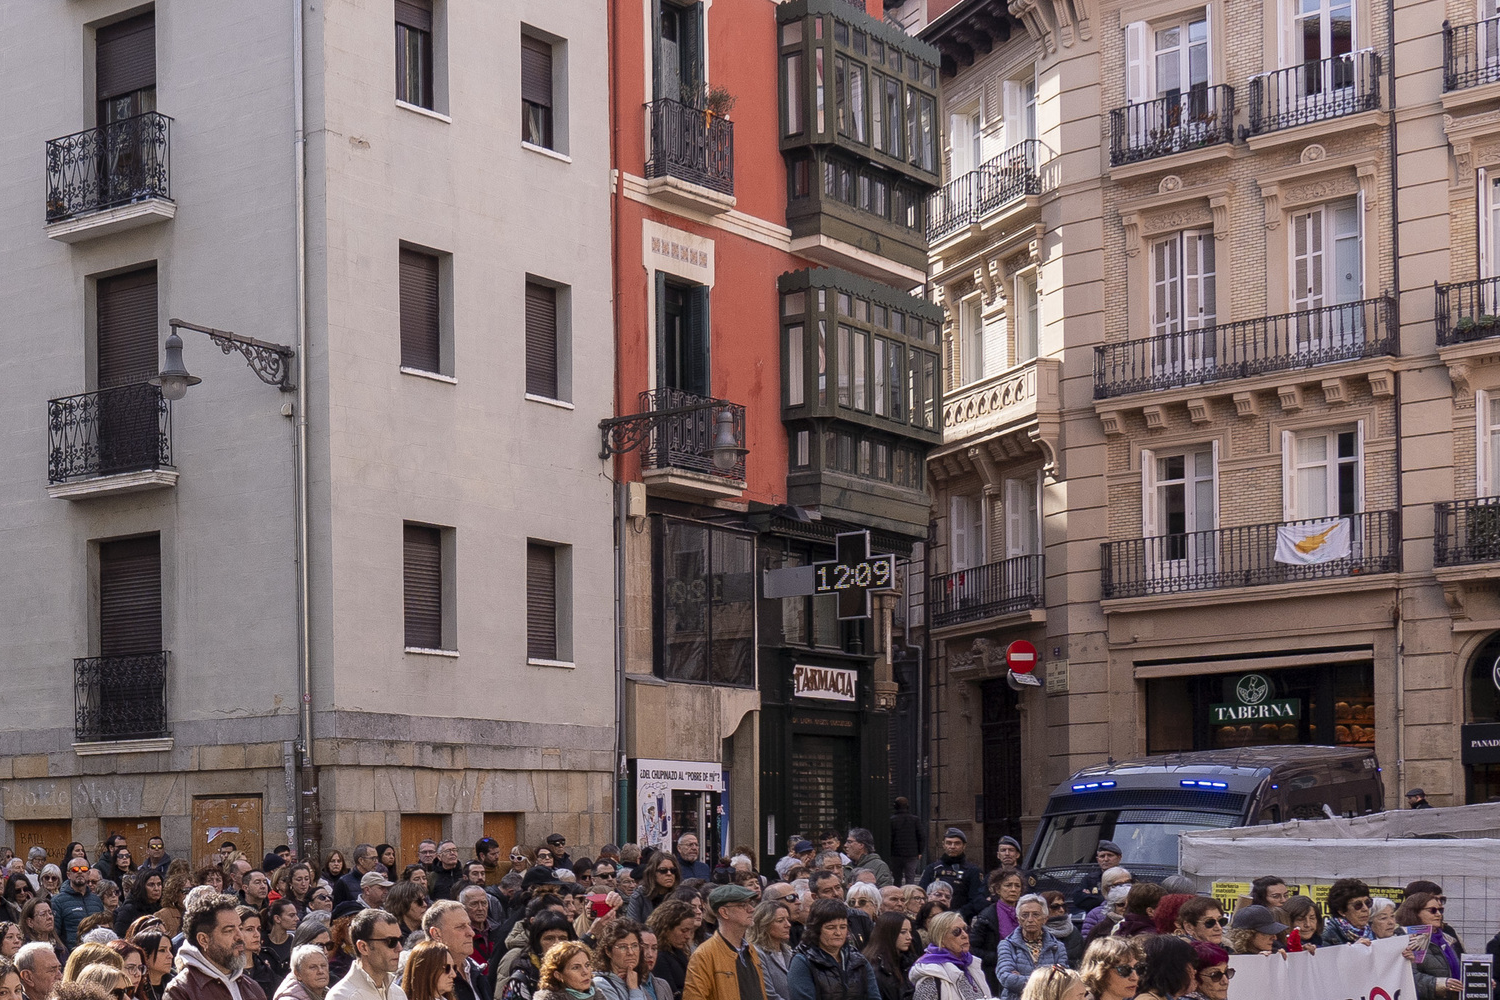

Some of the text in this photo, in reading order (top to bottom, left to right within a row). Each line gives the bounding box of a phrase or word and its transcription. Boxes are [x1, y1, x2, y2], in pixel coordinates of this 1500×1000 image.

[817, 560, 890, 591] 12:09
[794, 666, 854, 698] FARMACIA
[1215, 703, 1294, 721] TABERNA
[652, 770, 678, 780] CHUPINAZO
[678, 772, 684, 780] AL
[702, 773, 709, 782] DE
[77, 782, 132, 813] Shop
